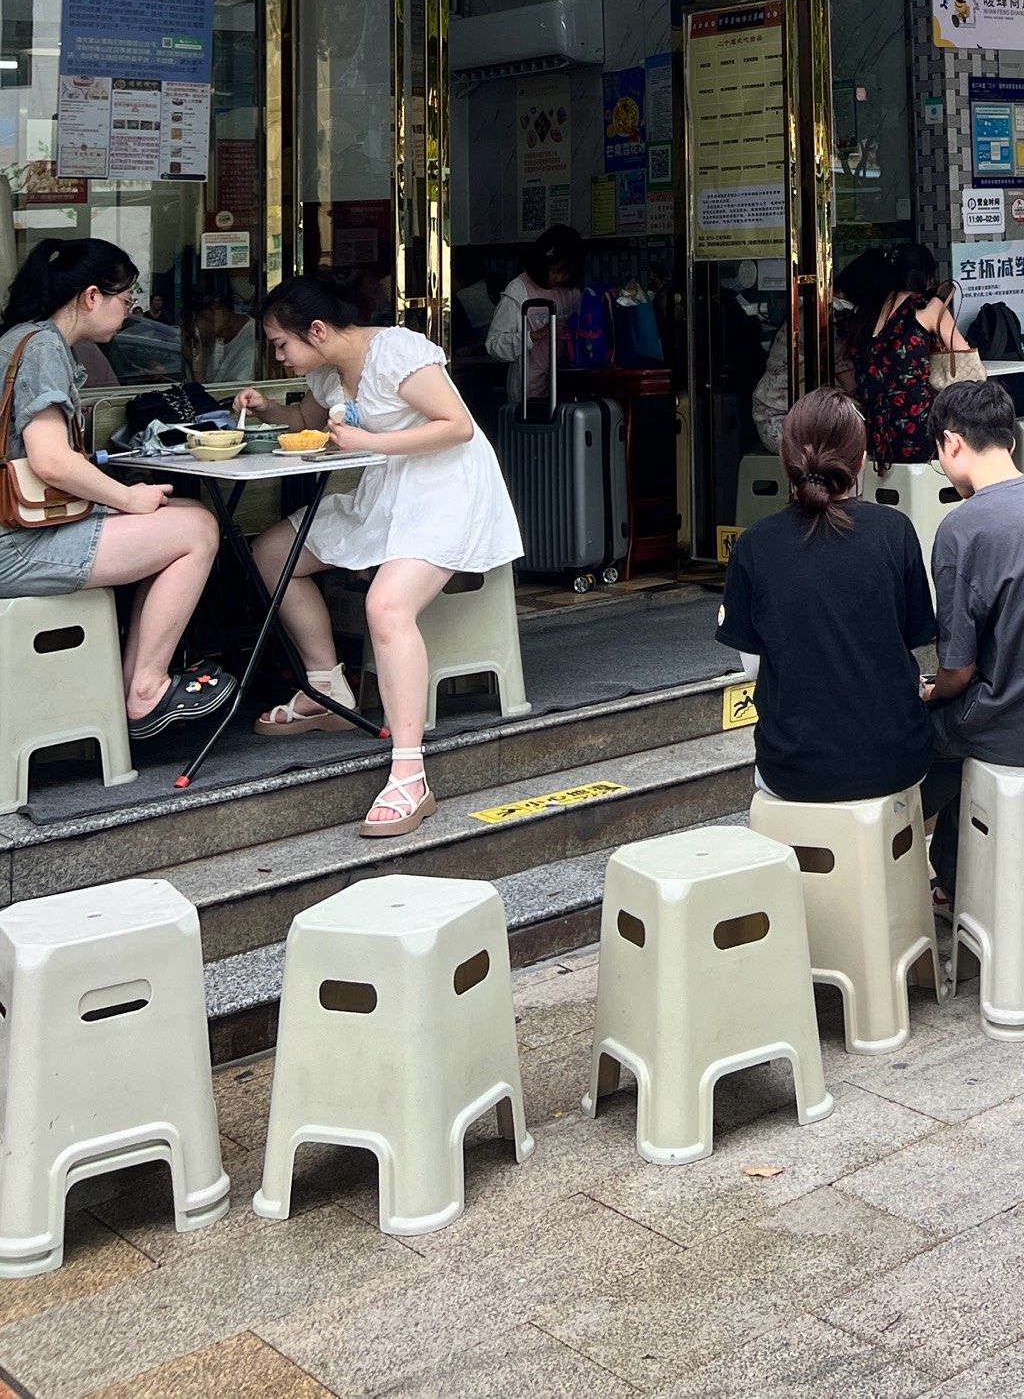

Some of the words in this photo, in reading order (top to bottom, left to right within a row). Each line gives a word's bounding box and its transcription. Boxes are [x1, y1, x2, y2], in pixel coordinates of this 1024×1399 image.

[977, 197, 1000, 207] 营业时间
[968, 214, 1000, 223] 11:00-02:00
